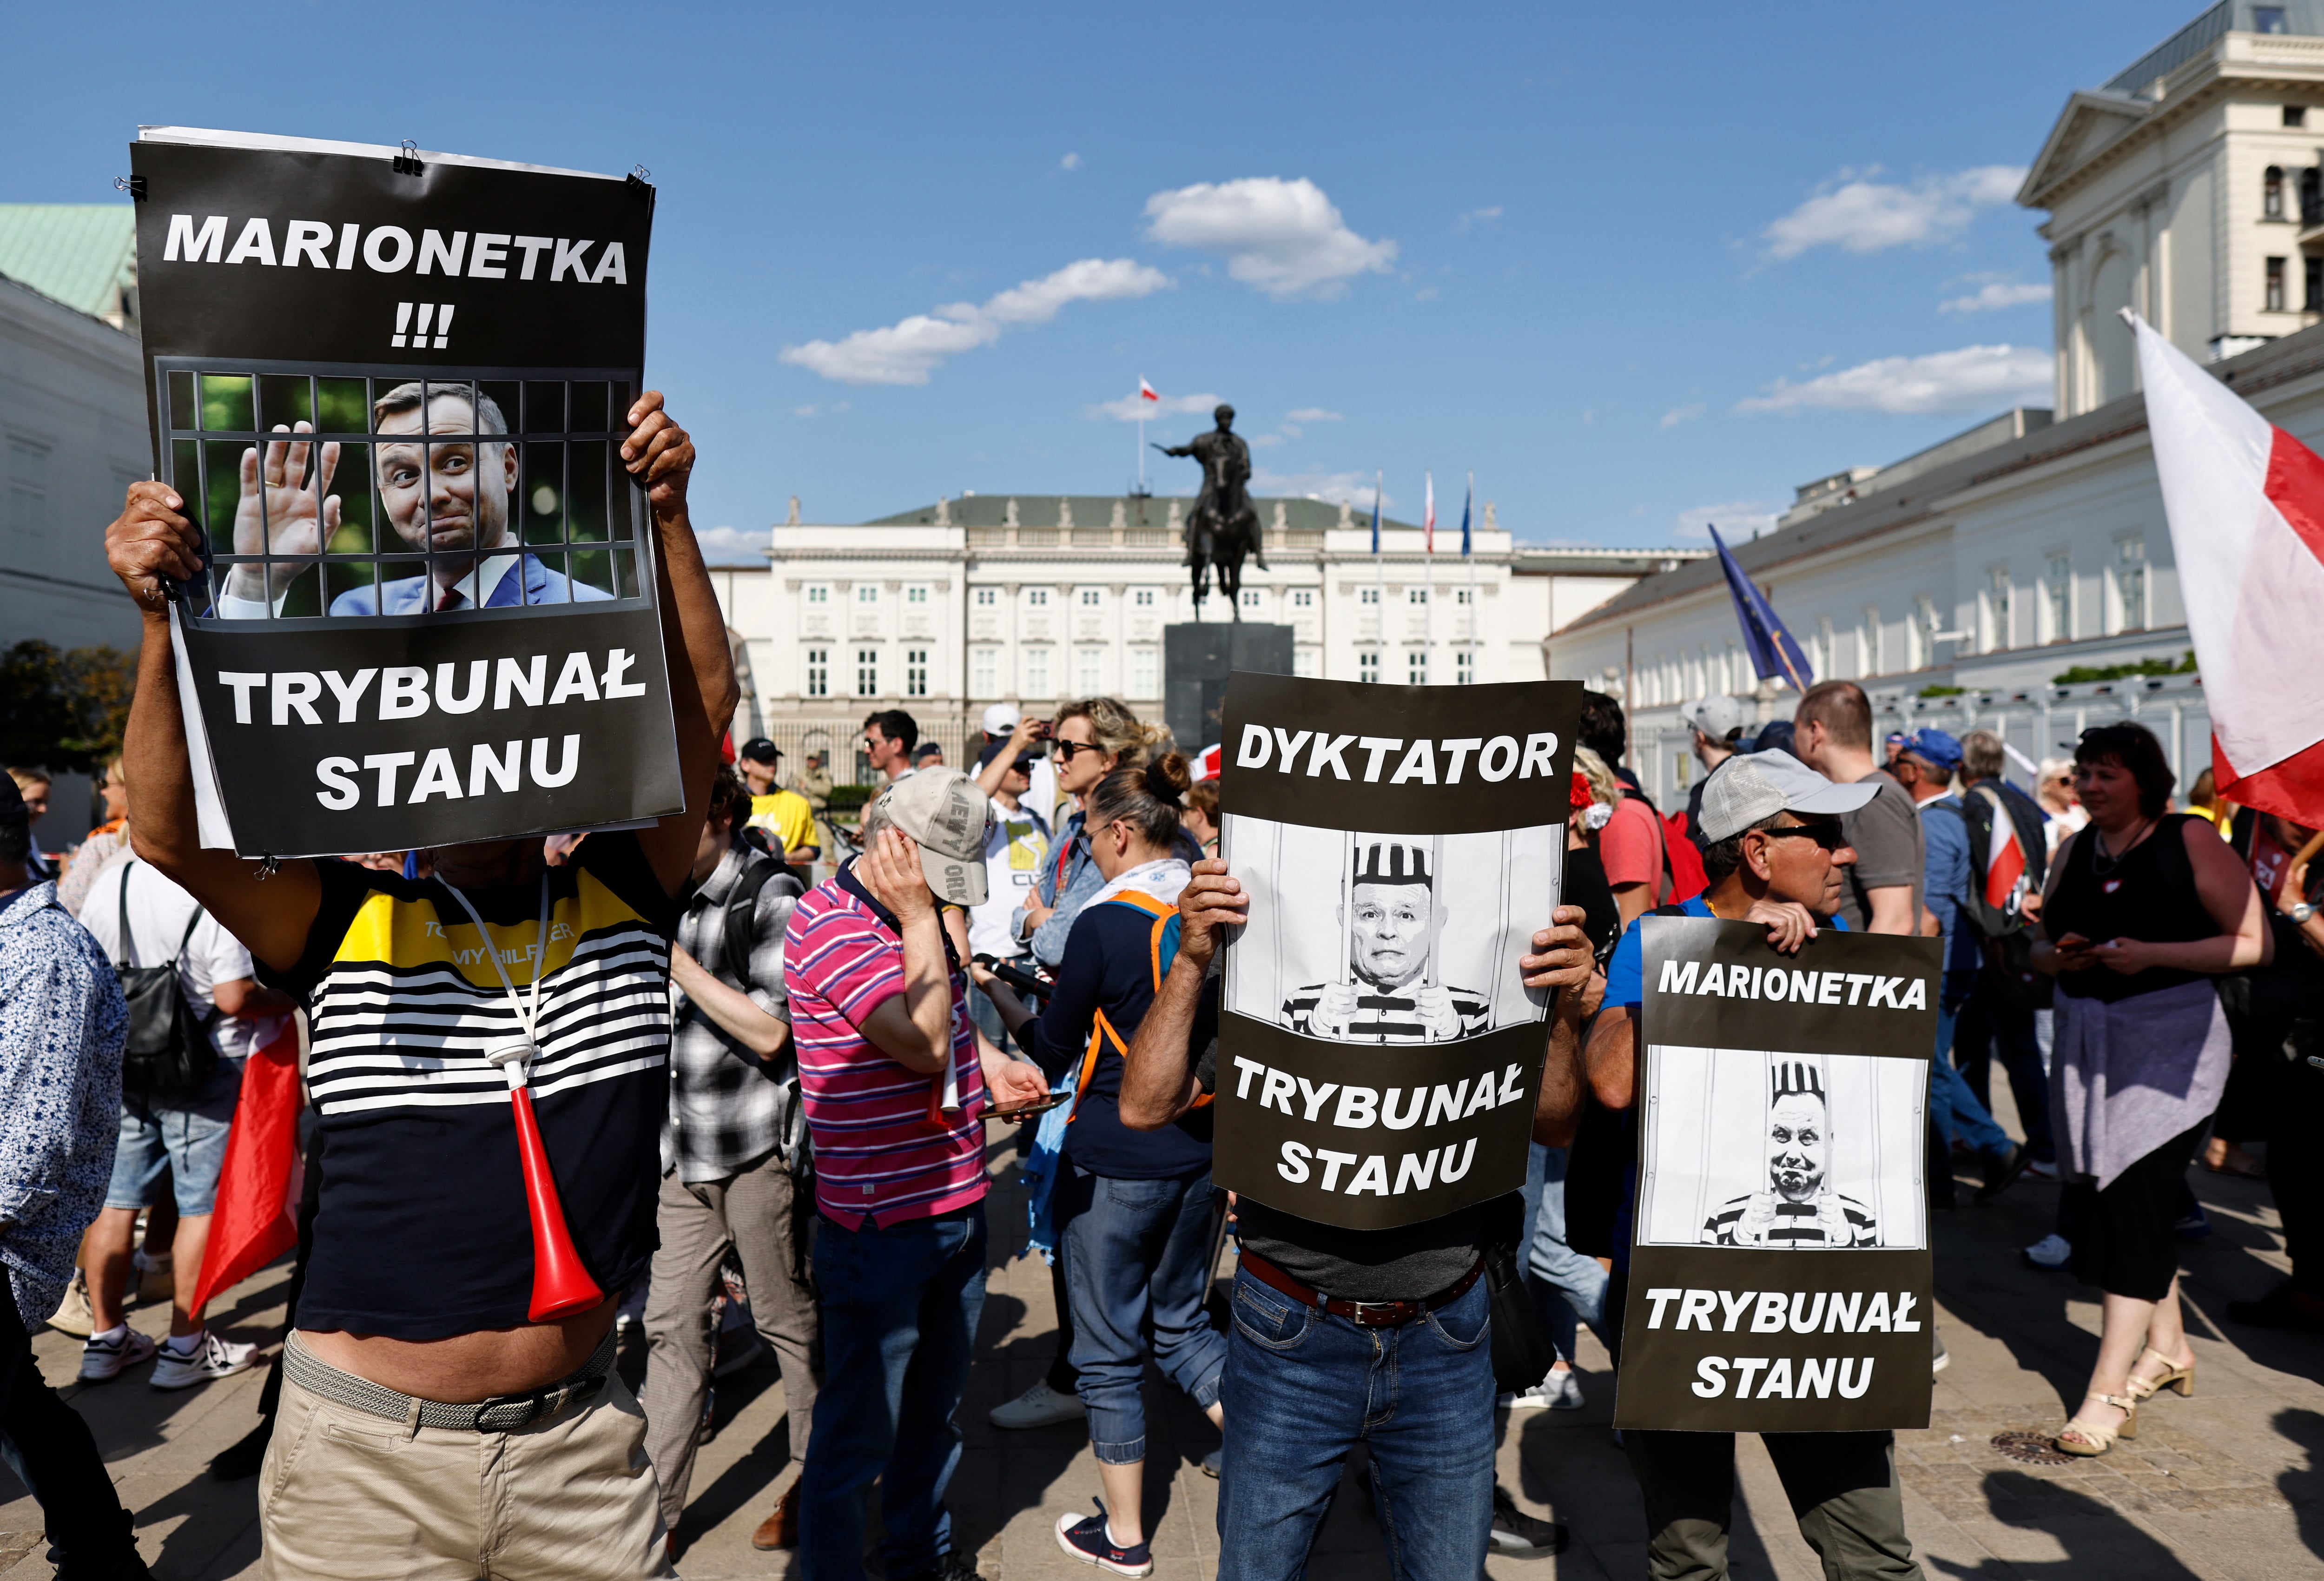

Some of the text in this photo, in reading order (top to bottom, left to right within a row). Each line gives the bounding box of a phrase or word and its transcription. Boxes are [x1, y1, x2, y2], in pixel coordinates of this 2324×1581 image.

[164, 214, 627, 284] MARIONETKA
[391, 303, 455, 349] !!!
[218, 648, 646, 725] TRYBUNAŁ
[316, 734, 581, 810] STANU
[1236, 723, 1558, 785] DYKTATOR
[1658, 960, 1926, 1010] MARIONETKA
[1234, 1055, 1524, 1130] TRYBUNAŁ
[1277, 1137, 1478, 1196] STANU
[1645, 1288, 1921, 1334] TRYBUNAŁ
[1691, 1356, 1875, 1399] STANU
